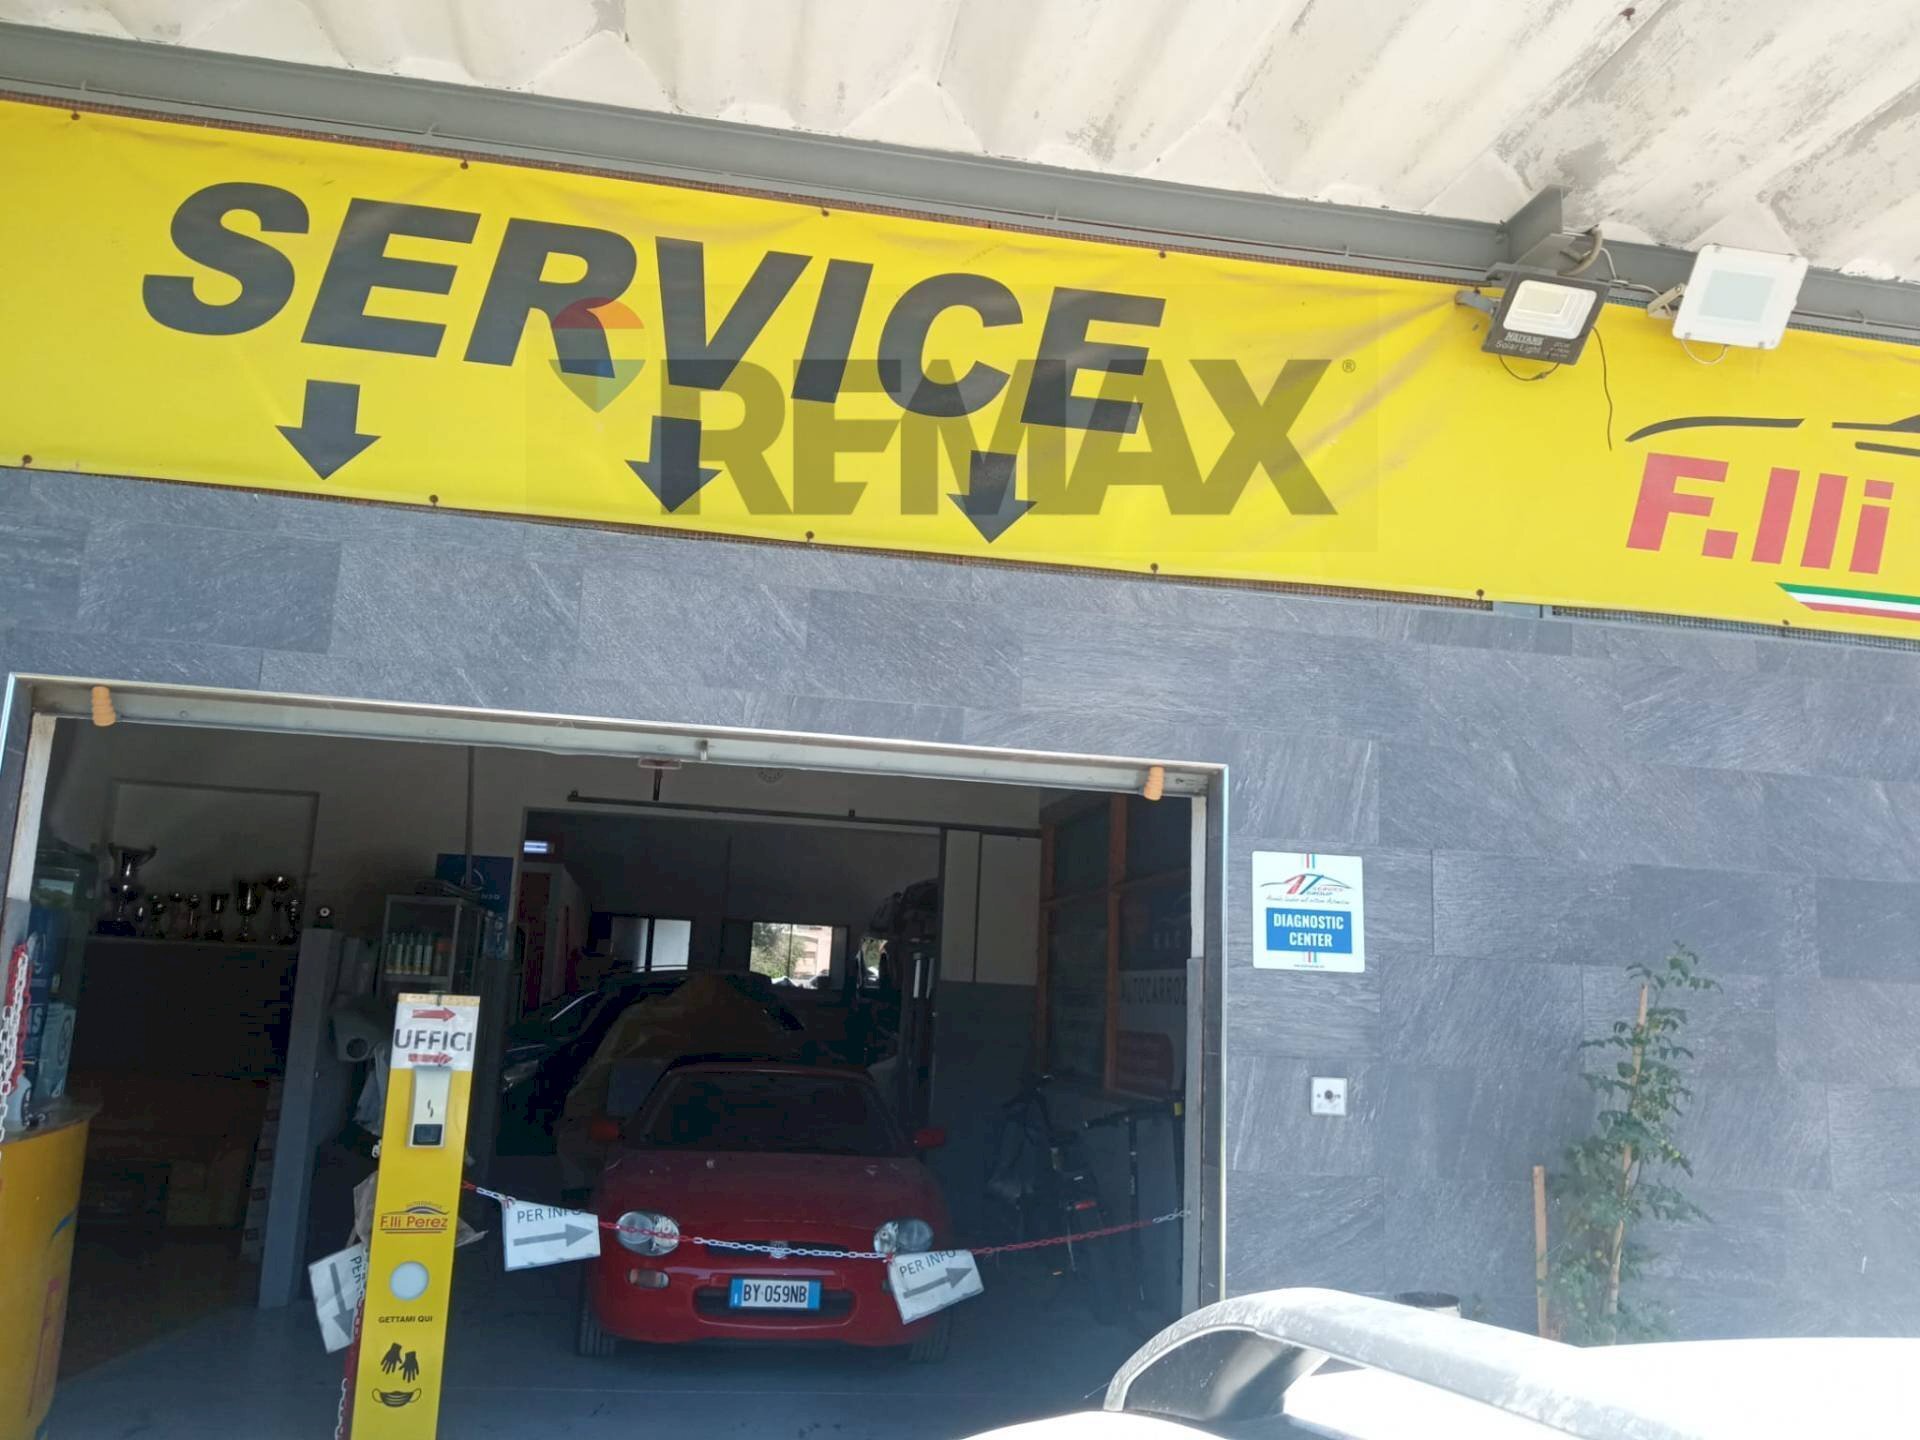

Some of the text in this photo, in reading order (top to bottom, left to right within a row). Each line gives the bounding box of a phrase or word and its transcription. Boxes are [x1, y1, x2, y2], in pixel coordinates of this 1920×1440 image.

[143, 182, 1166, 434] SERVICE
[1626, 452, 1894, 574] F.lli
[1273, 913, 1344, 930] DIAGNOSTIC
[1289, 932, 1333, 947] CENTER
[394, 1028, 474, 1052] UFFICI
[406, 1215, 449, 1229] Perez
[517, 1208, 544, 1224] PER
[899, 1260, 924, 1279] PER
[743, 1284, 807, 1303] BY 059NB
[378, 1315, 433, 1324] GETTAMI QUI
